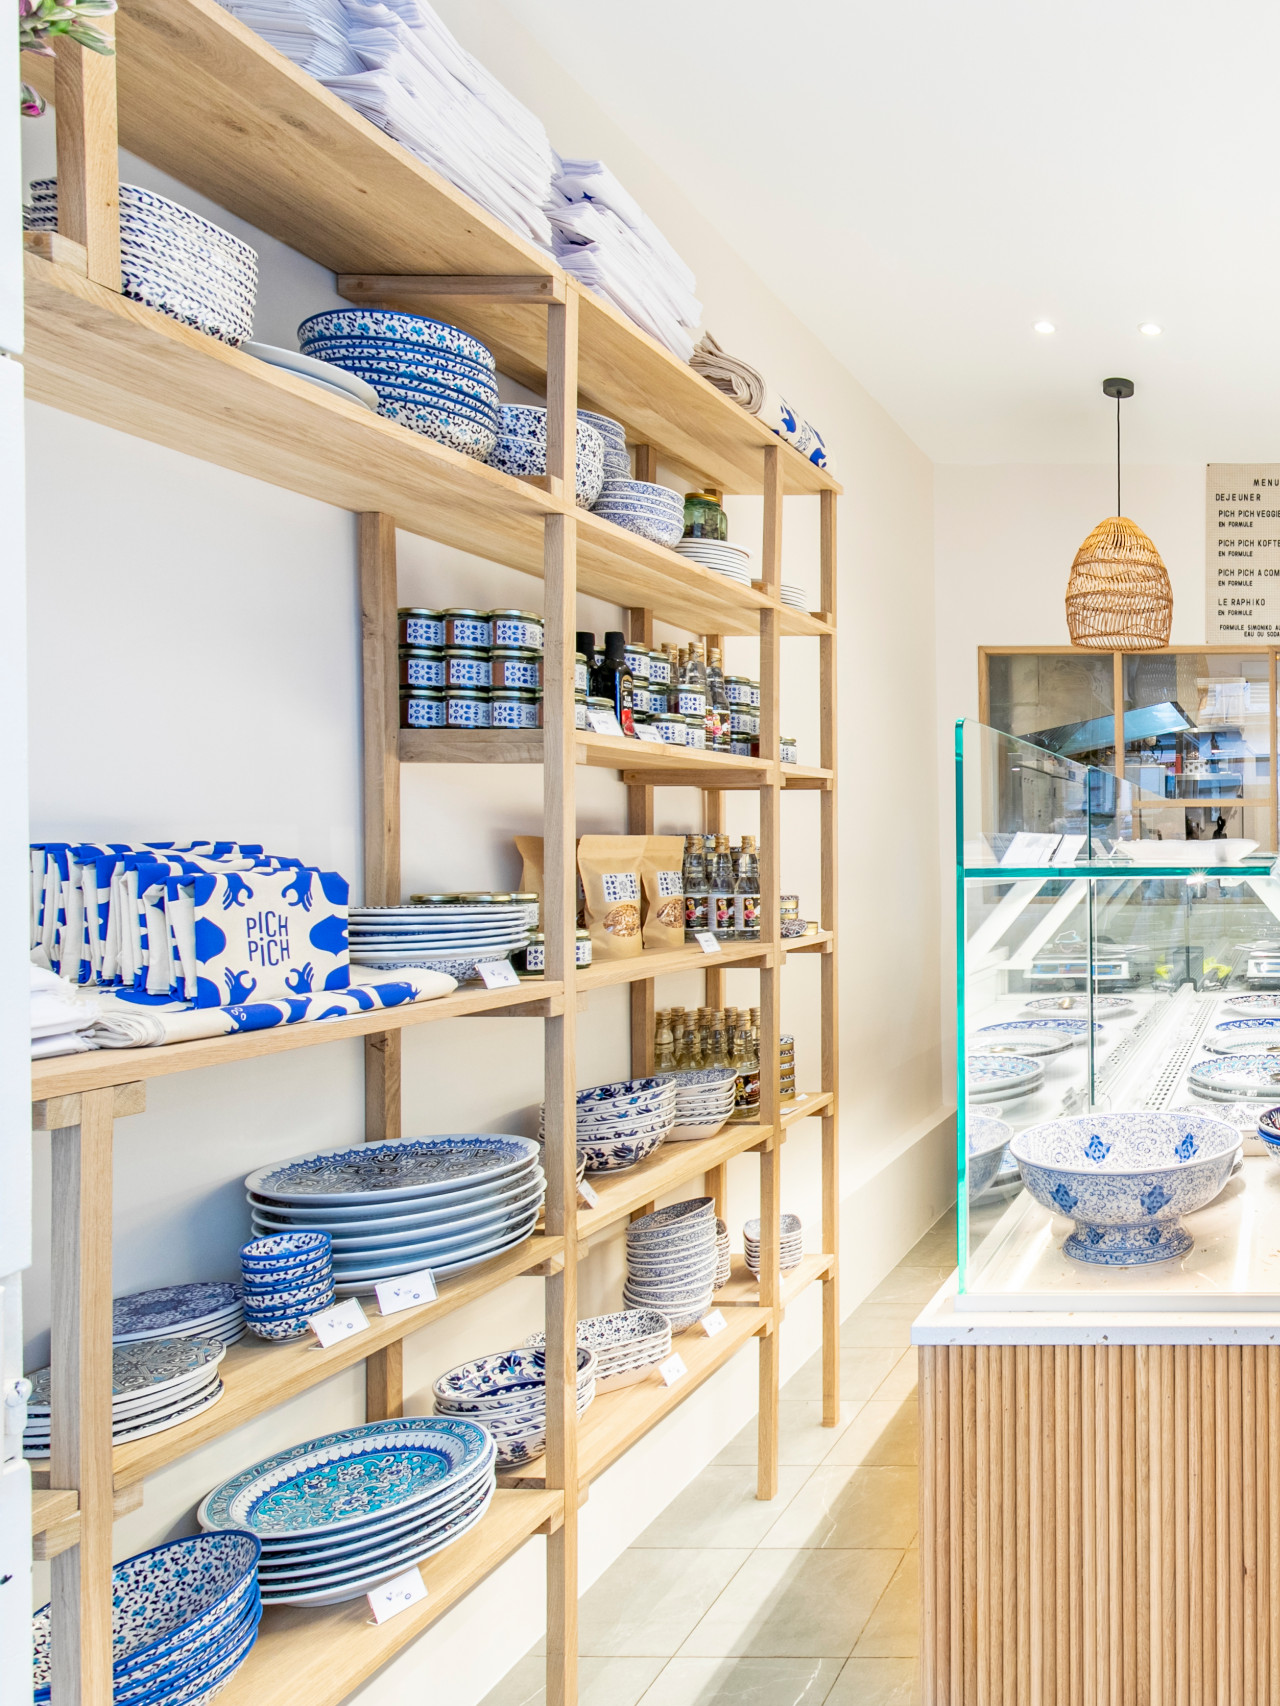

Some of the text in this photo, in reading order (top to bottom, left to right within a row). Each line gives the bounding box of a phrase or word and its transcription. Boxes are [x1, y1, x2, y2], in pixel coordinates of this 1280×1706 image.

[1253, 478, 1280, 487] MENU
[1215, 493, 1261, 502] DEJEUNER
[1218, 509, 1235, 518] PICH
[1237, 509, 1255, 518] PICH
[1218, 520, 1226, 528] EN
[1228, 520, 1254, 528] FORMULE
[1218, 539, 1235, 547] PICH
[1237, 539, 1255, 547] PICH
[1227, 550, 1253, 558] FORMULE
[1218, 568, 1235, 577] PICH
[1237, 568, 1255, 577] PICH
[1217, 598, 1228, 606] LE
[1230, 598, 1266, 607] RAPHIKO
[246, 910, 289, 938] PICH
